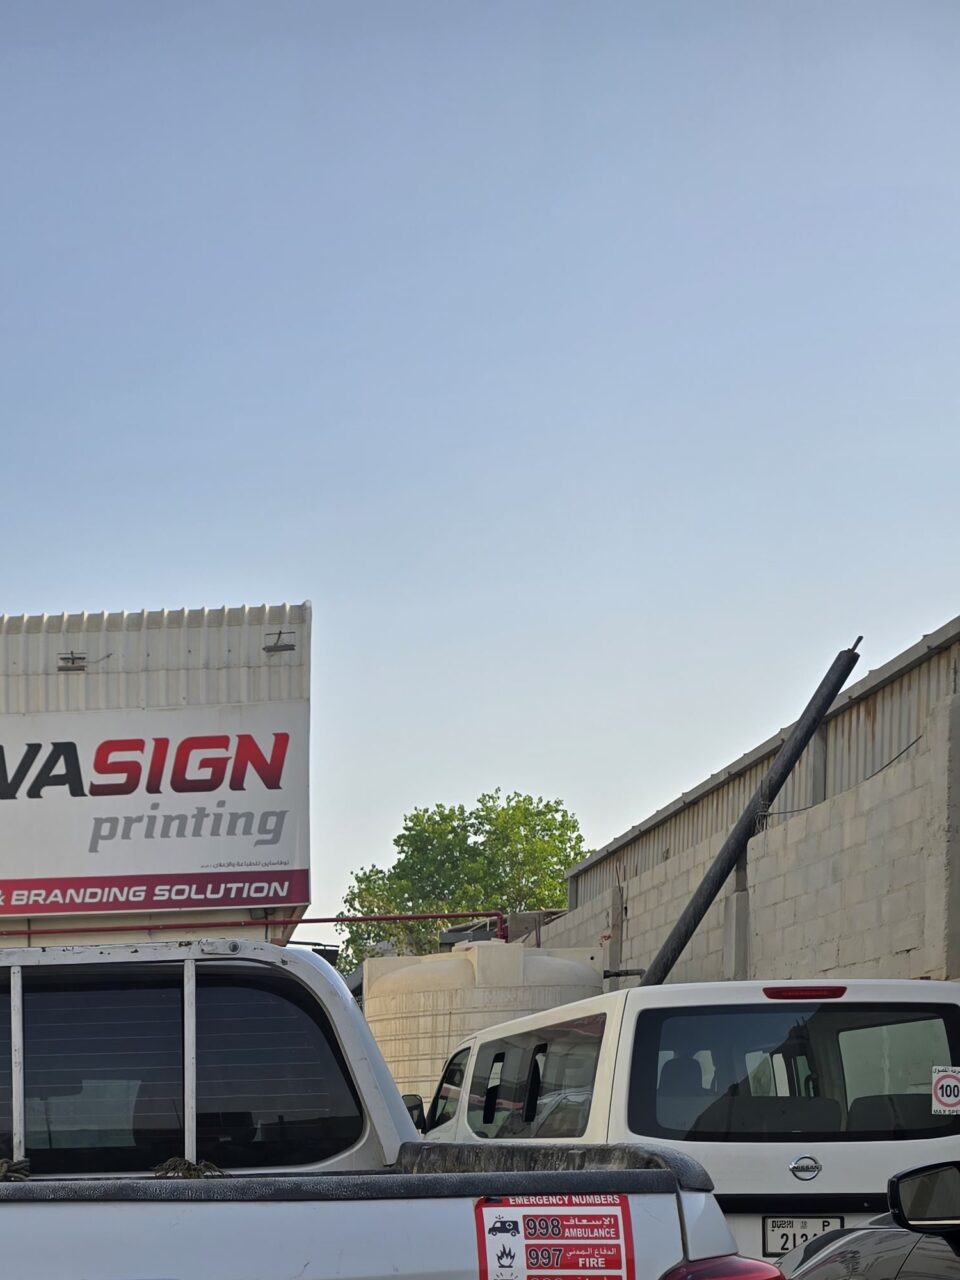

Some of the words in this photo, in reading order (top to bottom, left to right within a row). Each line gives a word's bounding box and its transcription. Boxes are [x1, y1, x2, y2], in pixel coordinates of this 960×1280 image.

[88, 800, 289, 853] printing
[10, 886, 147, 906] BRANDING
[153, 881, 290, 901] SOLUTION
[939, 1084, 960, 1098] 100
[509, 1195, 570, 1205] EMERGENCY
[571, 1194, 620, 1204] NUMBERS
[526, 1217, 562, 1238] 998
[564, 1228, 616, 1238] AMBULANCE
[822, 1220, 831, 1232] P
[528, 1248, 564, 1267] 997
[578, 1257, 606, 1268] FIRE
